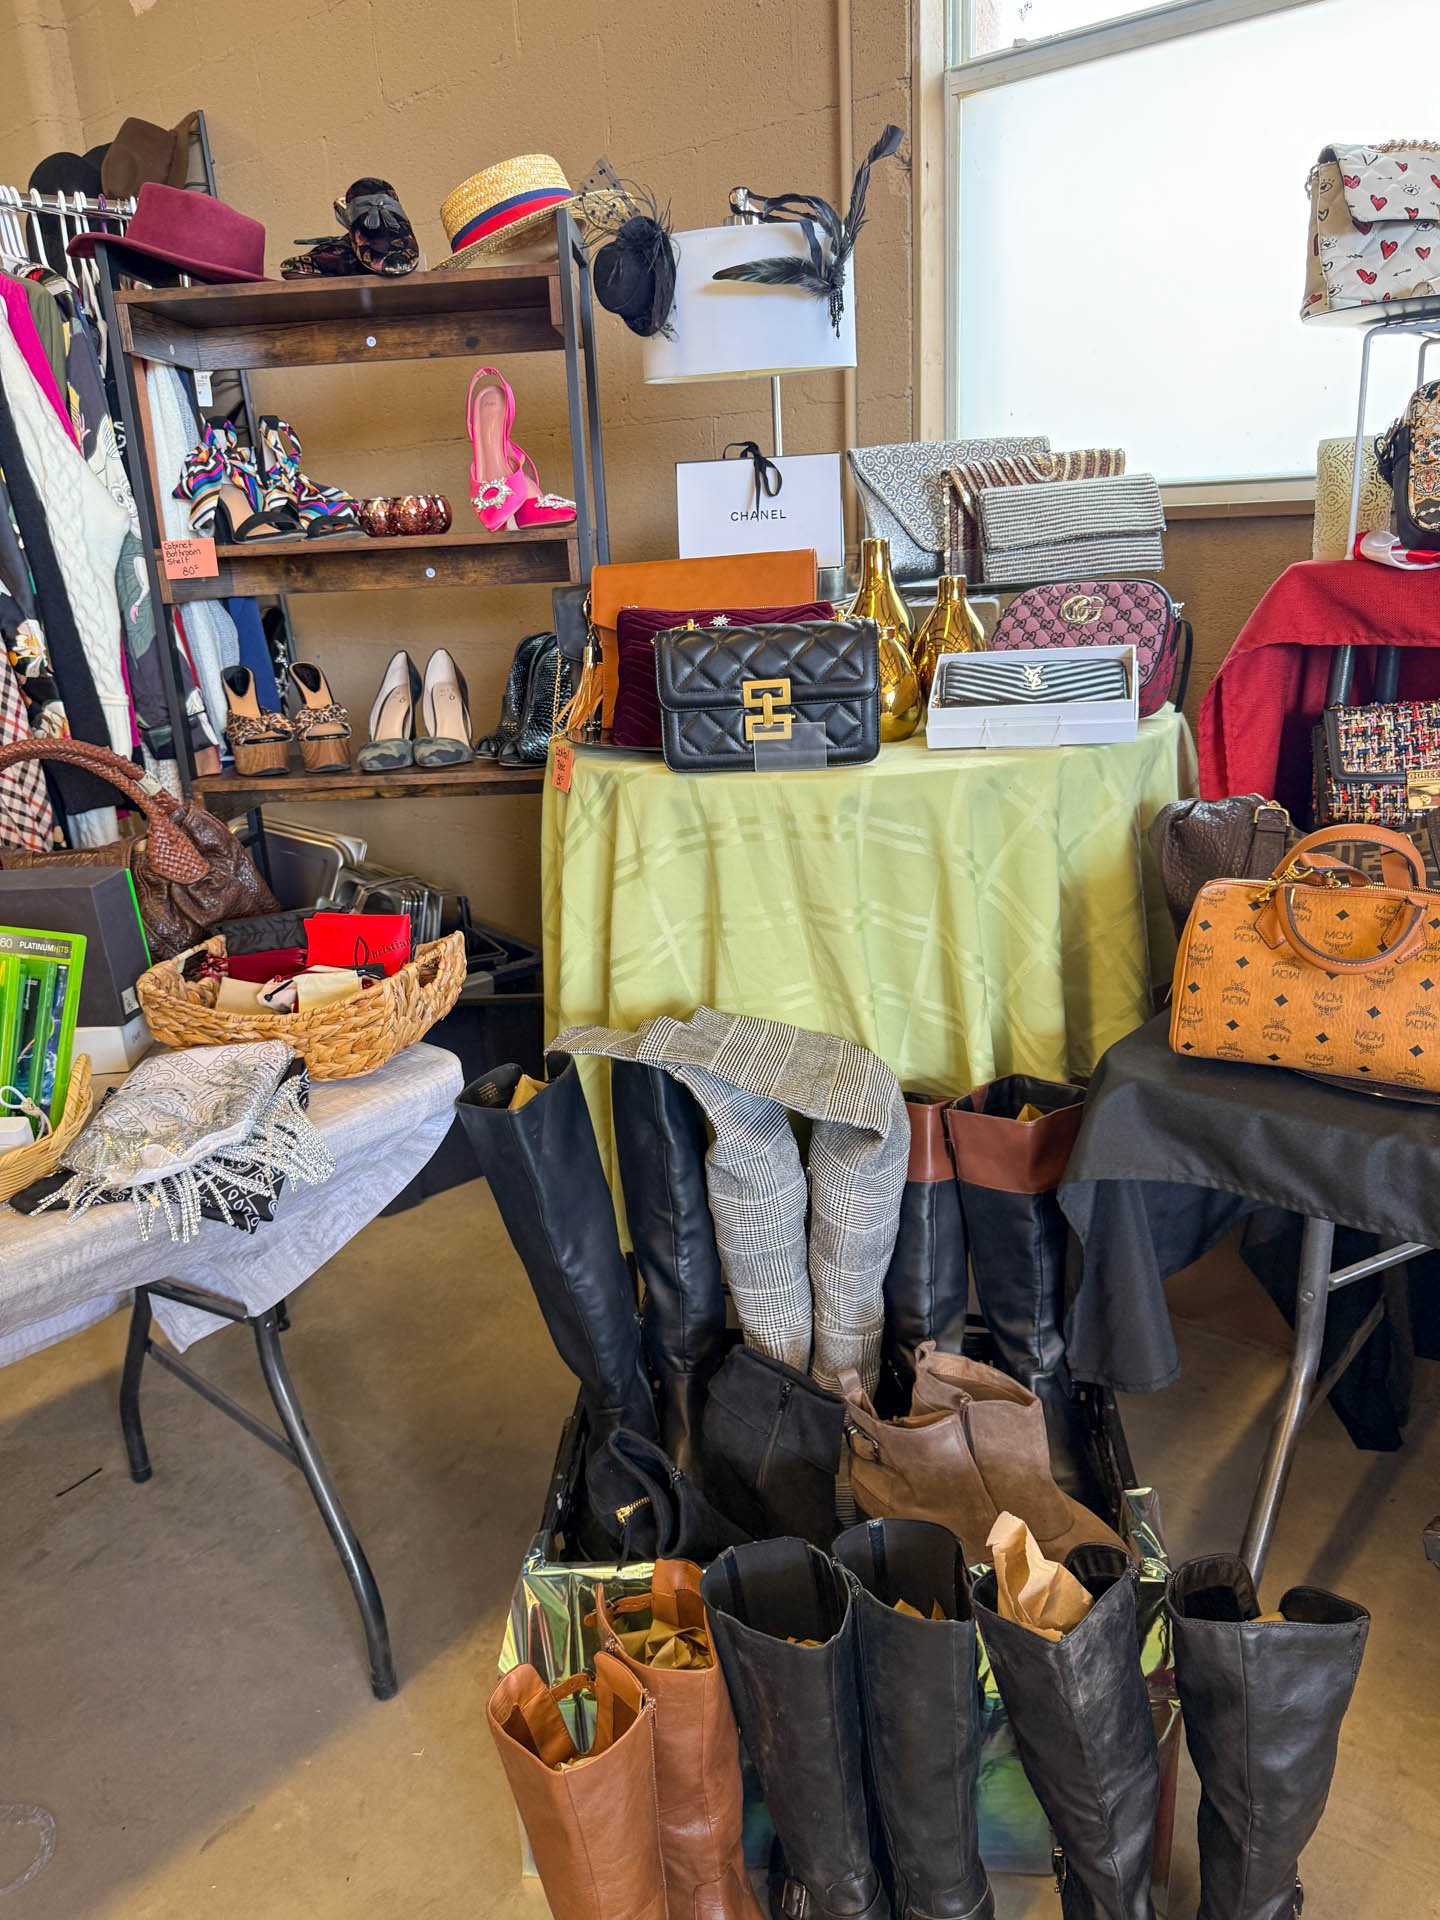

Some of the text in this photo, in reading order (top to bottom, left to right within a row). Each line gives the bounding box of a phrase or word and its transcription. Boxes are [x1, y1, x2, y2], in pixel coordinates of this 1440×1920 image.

[731, 509, 787, 521] CHANEL
[1324, 930, 1354, 941] MCM
[1188, 943, 1214, 954] MCM
[1313, 990, 1343, 1003] MCM
[1354, 1029, 1385, 1043] MCM
